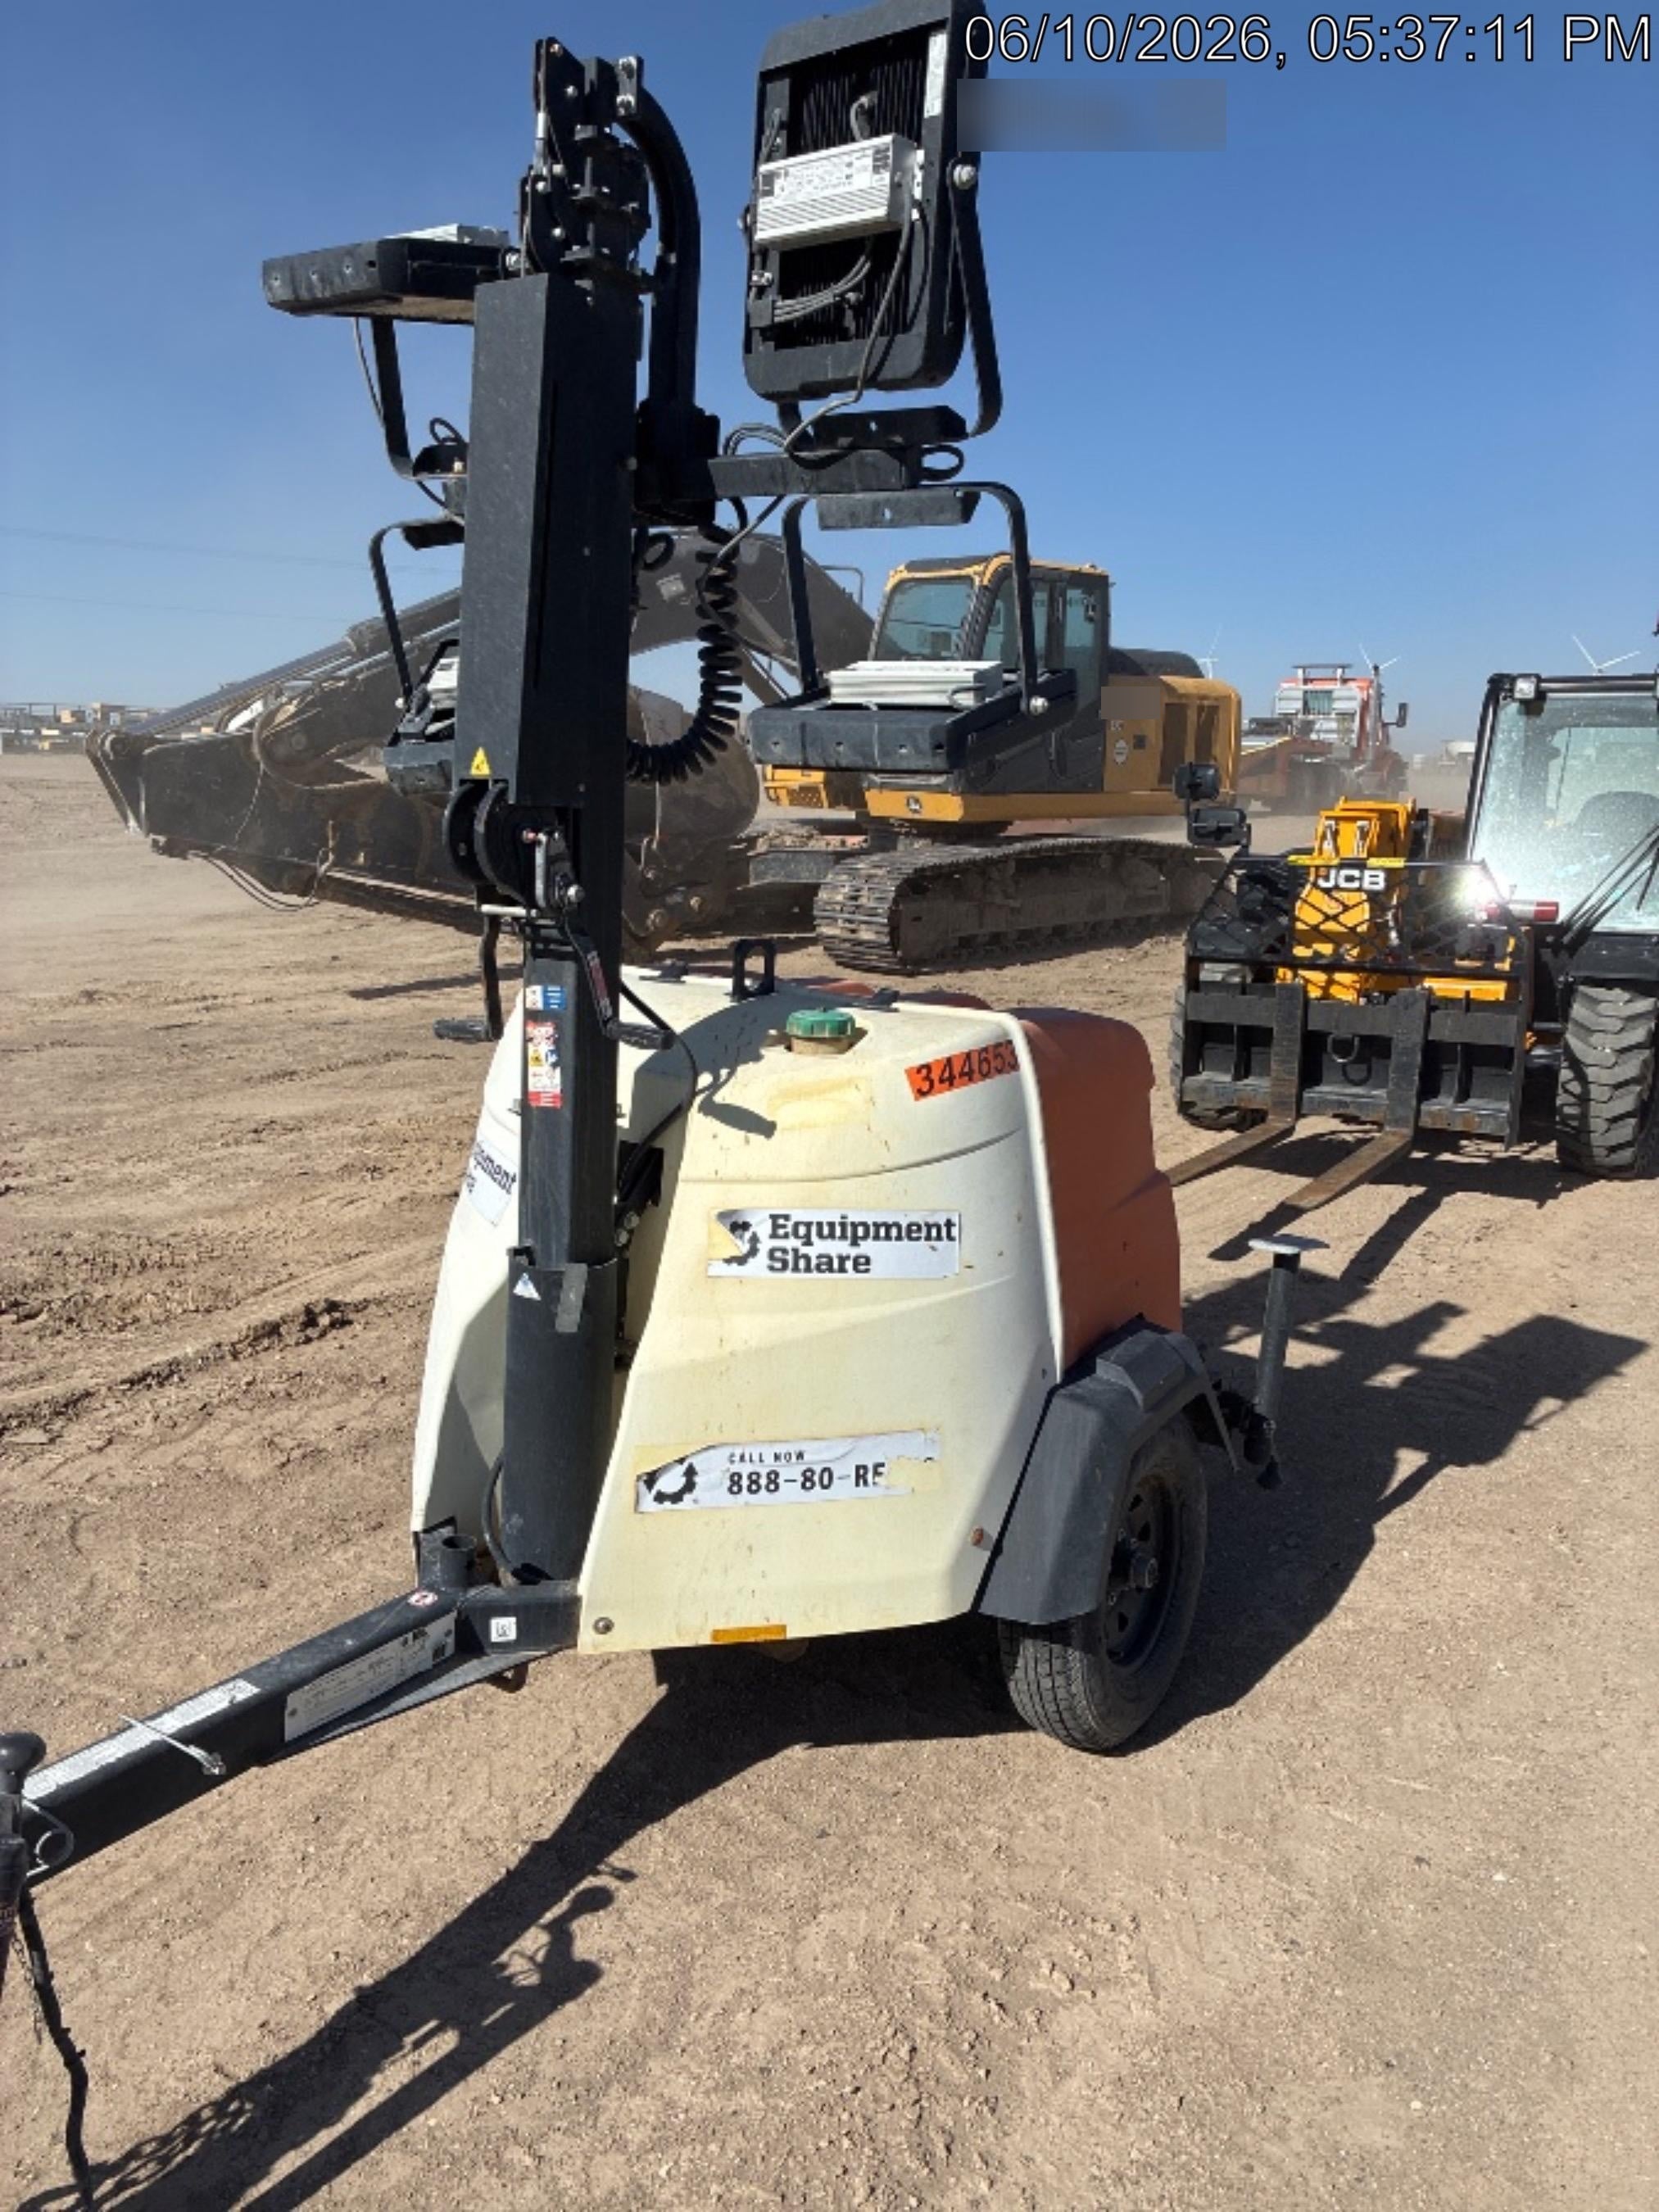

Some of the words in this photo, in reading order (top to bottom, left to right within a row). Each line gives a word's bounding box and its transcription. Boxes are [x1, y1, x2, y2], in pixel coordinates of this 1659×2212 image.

[1316, 868, 1386, 891] JCB
[915, 1038, 1019, 1096] 344653
[768, 1213, 957, 1247] Equipment
[766, 1245, 873, 1275] Share
[727, 1452, 765, 1464] CALL
[773, 1449, 806, 1462] NOW
